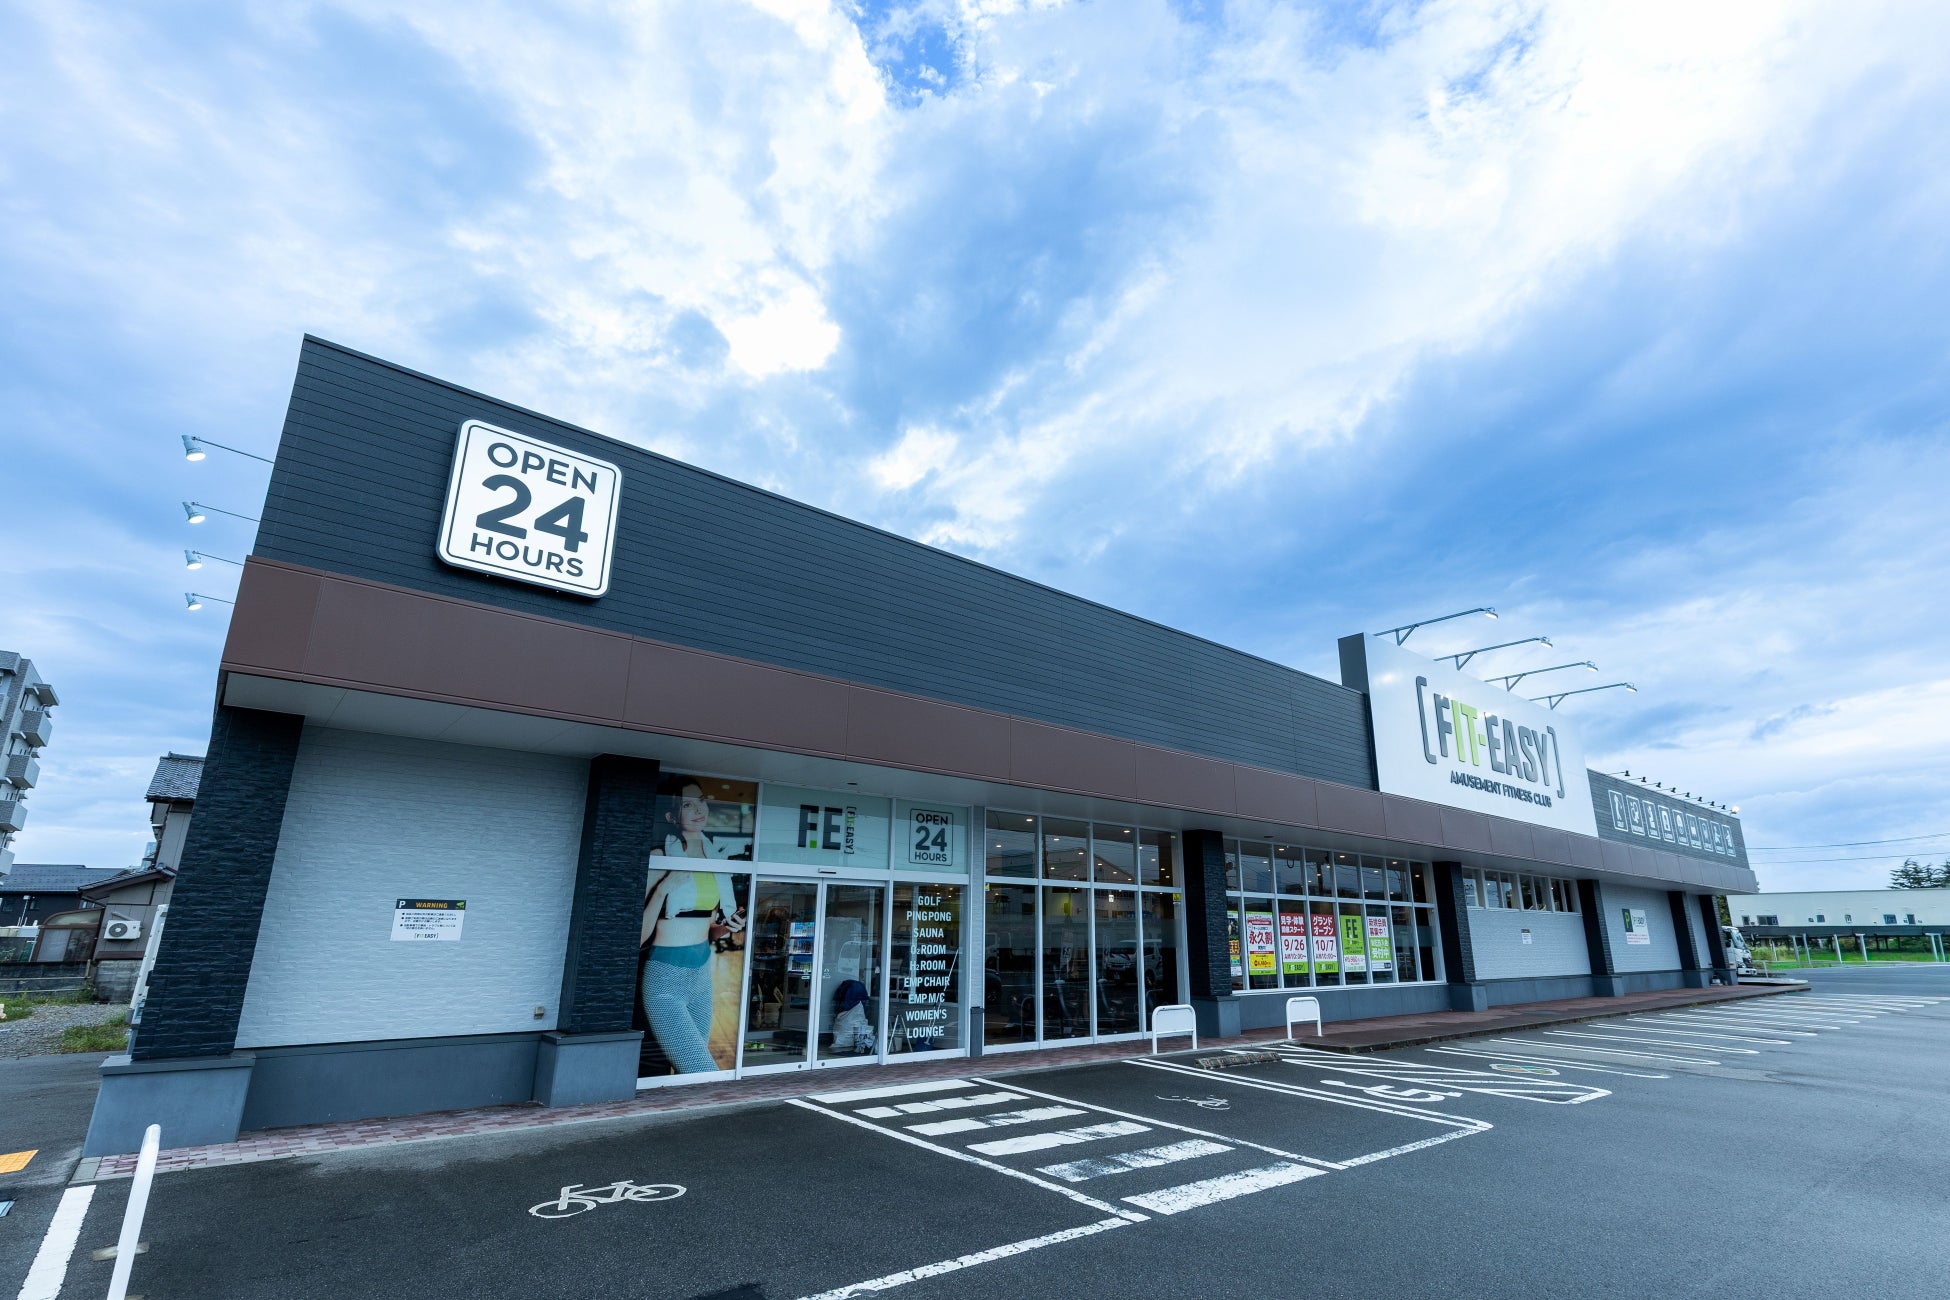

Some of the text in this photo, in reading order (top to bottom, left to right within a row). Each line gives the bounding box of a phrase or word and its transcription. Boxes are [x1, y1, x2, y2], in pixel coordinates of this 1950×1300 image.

[487, 442, 598, 495] OPEN
[475, 474, 589, 553] 24
[470, 532, 584, 577] HOURS
[1450, 770, 1552, 808] AMUSEMENT FITNESS CLUB
[916, 813, 949, 826] OPEN
[915, 826, 947, 852] 24
[914, 851, 947, 862] HOURS
[398, 900, 406, 908] P
[918, 895, 941, 906] GOLF
[906, 910, 952, 922] PING PONG
[1312, 916, 1333, 926] グランド
[913, 927, 944, 938] SAUNA
[1313, 926, 1334, 936] オープン
[1249, 930, 1273, 945] 永久割
[920, 944, 946, 955] ROOM
[1283, 938, 1305, 951] 9/26
[1315, 939, 1335, 952] 10/7
[920, 960, 946, 971] ROOM
[904, 976, 950, 988] EMP CHAIR
[908, 992, 945, 1004] EMP M/C
[905, 1009, 947, 1021] WOMEN'S
[906, 1025, 945, 1039] LOUNGE
